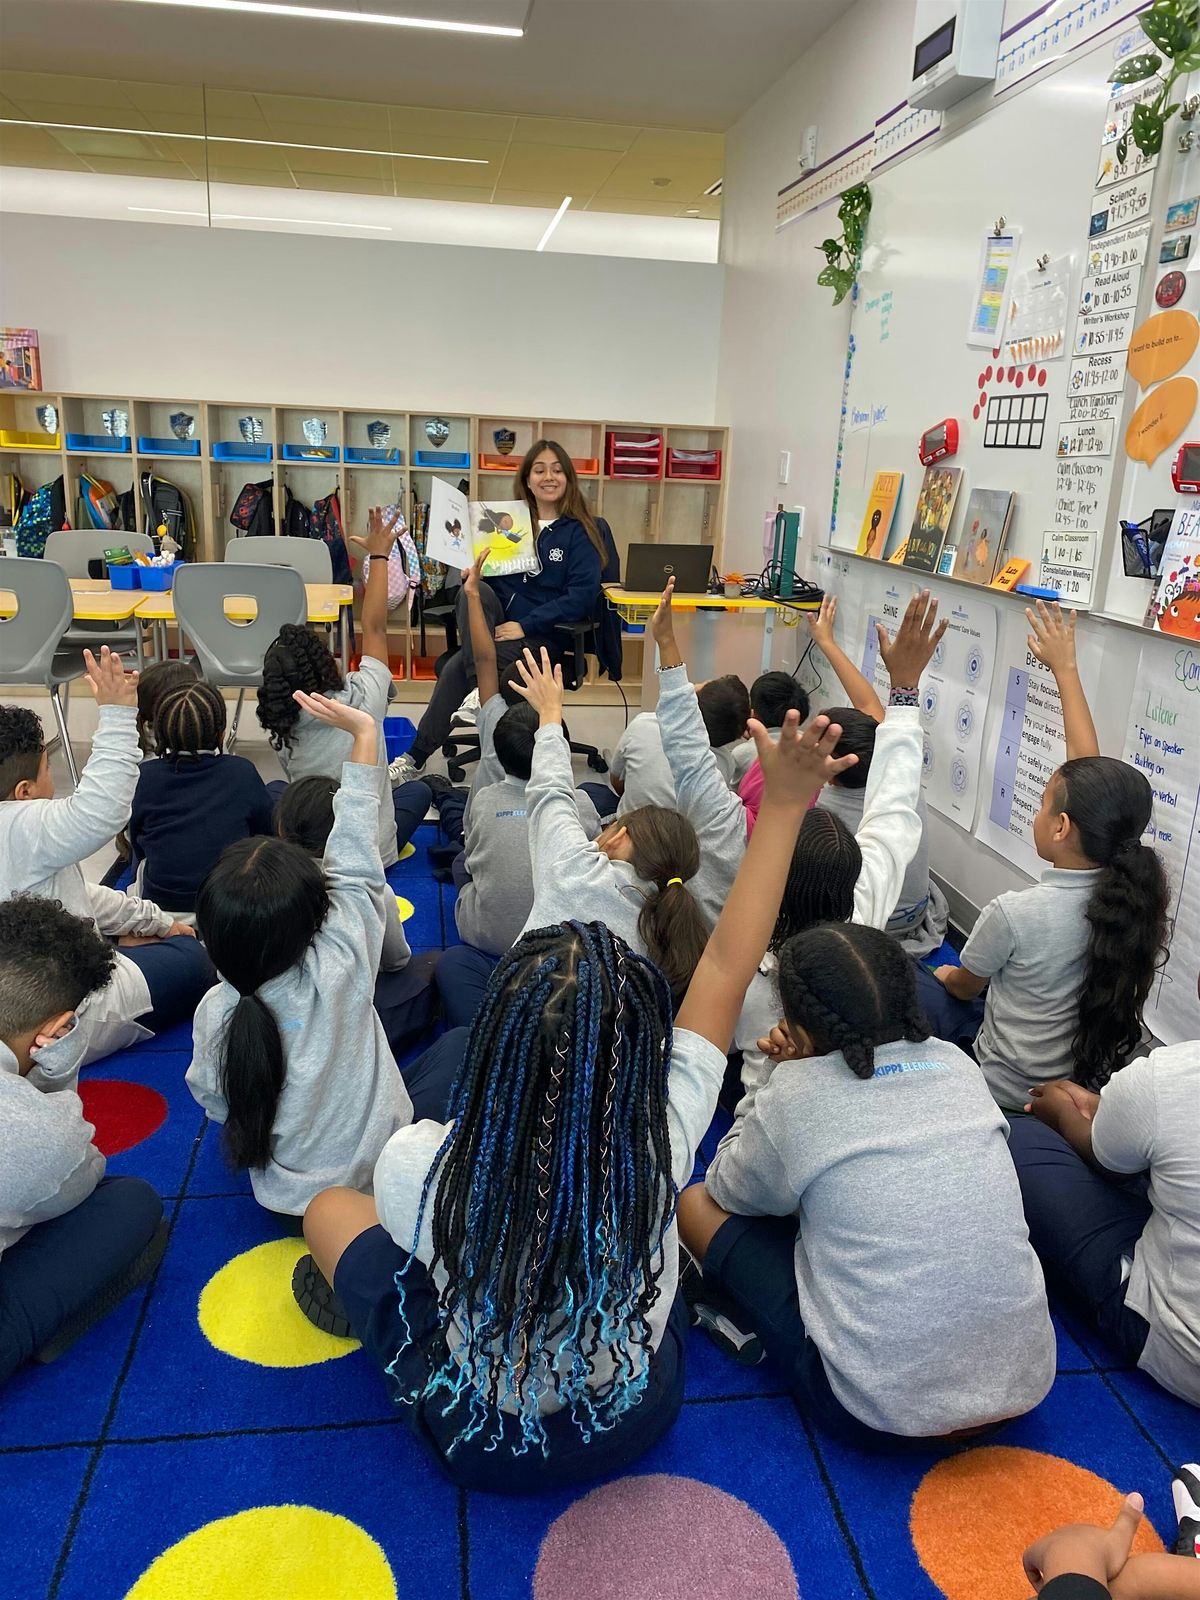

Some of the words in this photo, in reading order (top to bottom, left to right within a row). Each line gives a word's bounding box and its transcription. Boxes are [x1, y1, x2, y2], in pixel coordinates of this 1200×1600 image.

[1008, 60, 1015, 72] 12
[1040, 40, 1047, 53] 15
[1051, 32, 1059, 46] 16
[1063, 24, 1072, 38] 17
[1076, 16, 1084, 30] 18
[1089, 8, 1097, 21] 19
[1101, 0, 1110, 14] 20
[1115, 94, 1142, 112] Morning
[1109, 187, 1137, 206] Science
[1091, 234, 1126, 251] Independent
[1127, 226, 1150, 240] Reading
[1094, 275, 1111, 288] Read
[1111, 270, 1130, 284] Aloud
[1083, 316, 1104, 325] Writer's
[1104, 312, 1130, 322] Workshop
[1151, 339, 1165, 348] build
[1088, 356, 1112, 367] Recess
[1077, 427, 1096, 436] Lunch
[1052, 533, 1064, 541] Calm
[1064, 533, 1089, 542] Classroom
[1042, 565, 1072, 576] Constellation
[1072, 569, 1091, 582] Meeting
[883, 603, 898, 618] SHINE
[1026, 651, 1036, 668] Be
[1015, 674, 1020, 686] S
[1028, 678, 1040, 693] Stay
[1027, 692, 1043, 708] follow
[1012, 710, 1017, 721] T
[1146, 690, 1178, 726] Listener
[1024, 714, 1032, 728] Try
[1033, 720, 1044, 731] your
[1045, 723, 1057, 738] best
[1022, 730, 1040, 746] engage
[1139, 727, 1153, 748] Eyes
[1154, 738, 1161, 748] on
[1005, 745, 1010, 756] A
[1018, 751, 1028, 763] Act
[1027, 756, 1042, 772] safely
[1042, 764, 1053, 776] and
[1155, 766, 1165, 776] on
[1017, 767, 1028, 777] your
[1000, 787, 1006, 799] R
[1015, 780, 1027, 792] each
[1013, 793, 1033, 813] Respect
[1011, 809, 1027, 824] others
[1009, 822, 1024, 837] space.
[1158, 830, 1172, 842] more
